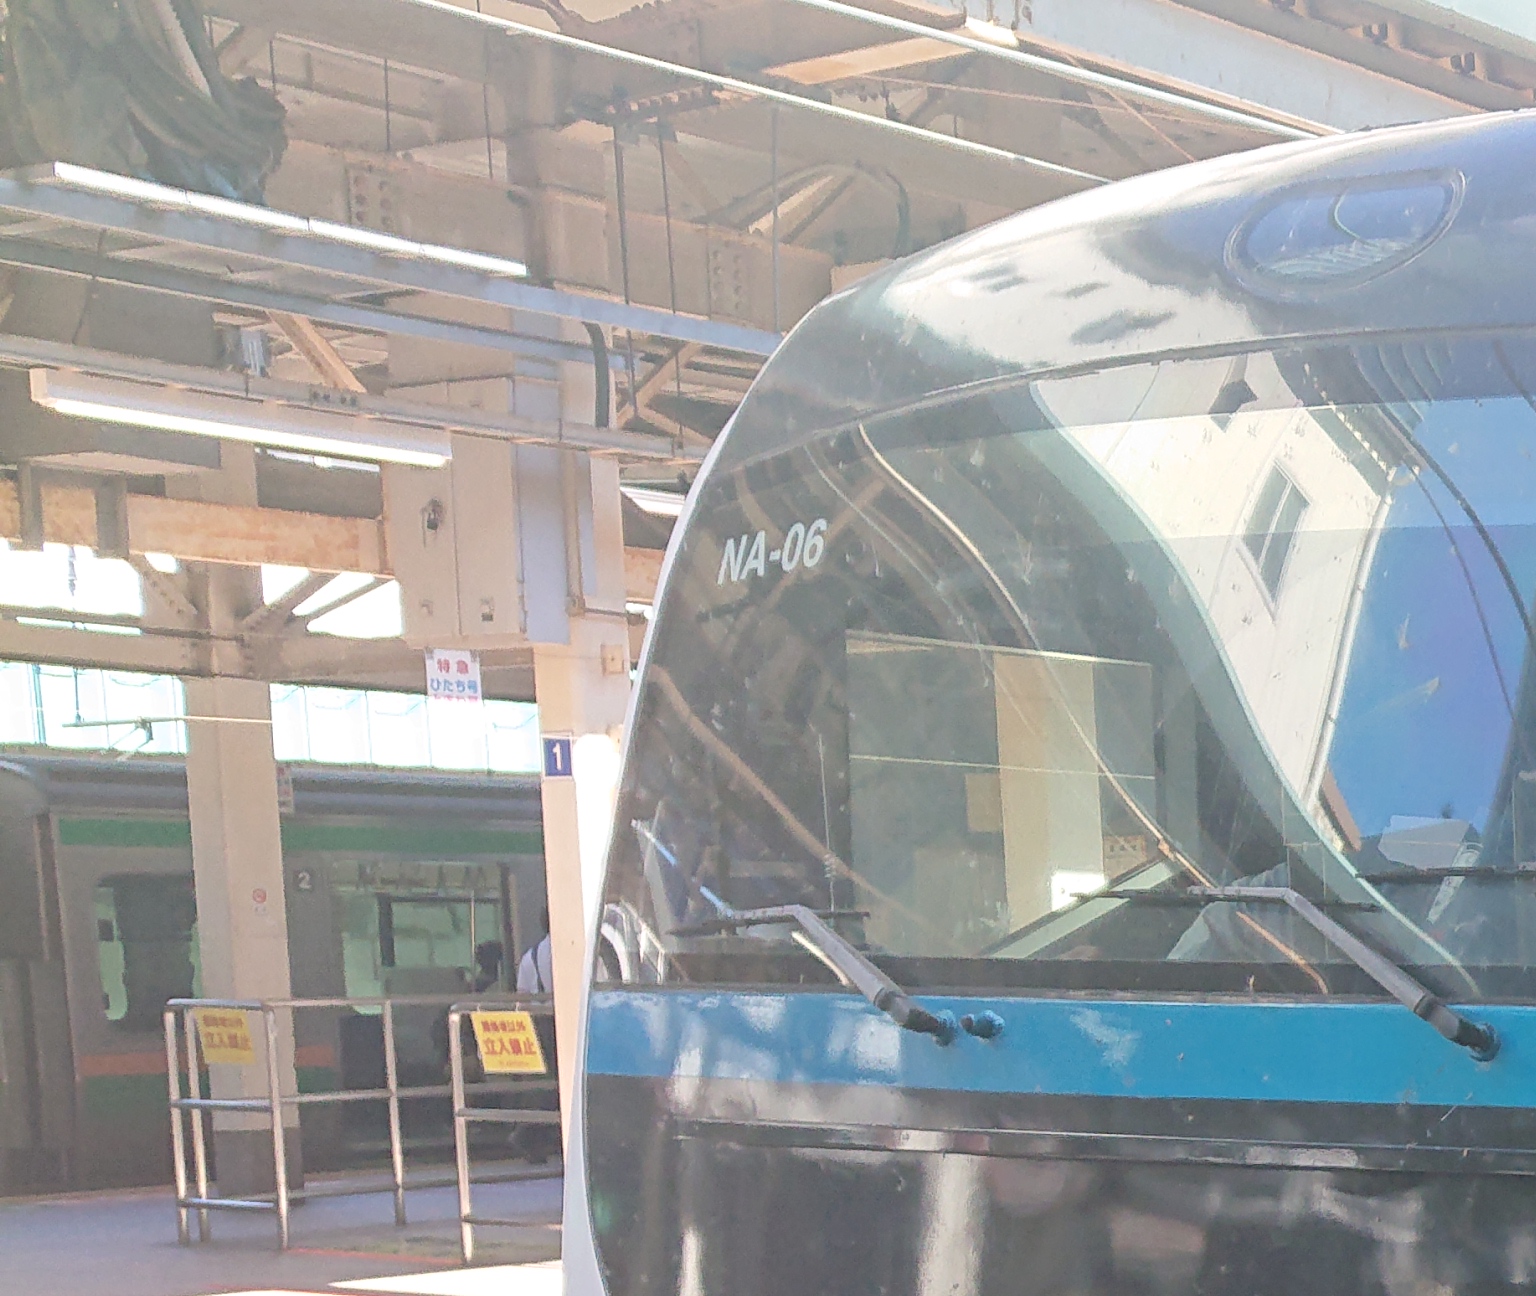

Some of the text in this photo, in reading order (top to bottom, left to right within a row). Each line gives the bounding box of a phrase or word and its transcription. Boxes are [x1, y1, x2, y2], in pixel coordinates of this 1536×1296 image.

[717, 518, 828, 586] NA-06
[430, 677, 478, 694] ひたち号
[552, 742, 563, 771] 1
[298, 871, 312, 890] 2
